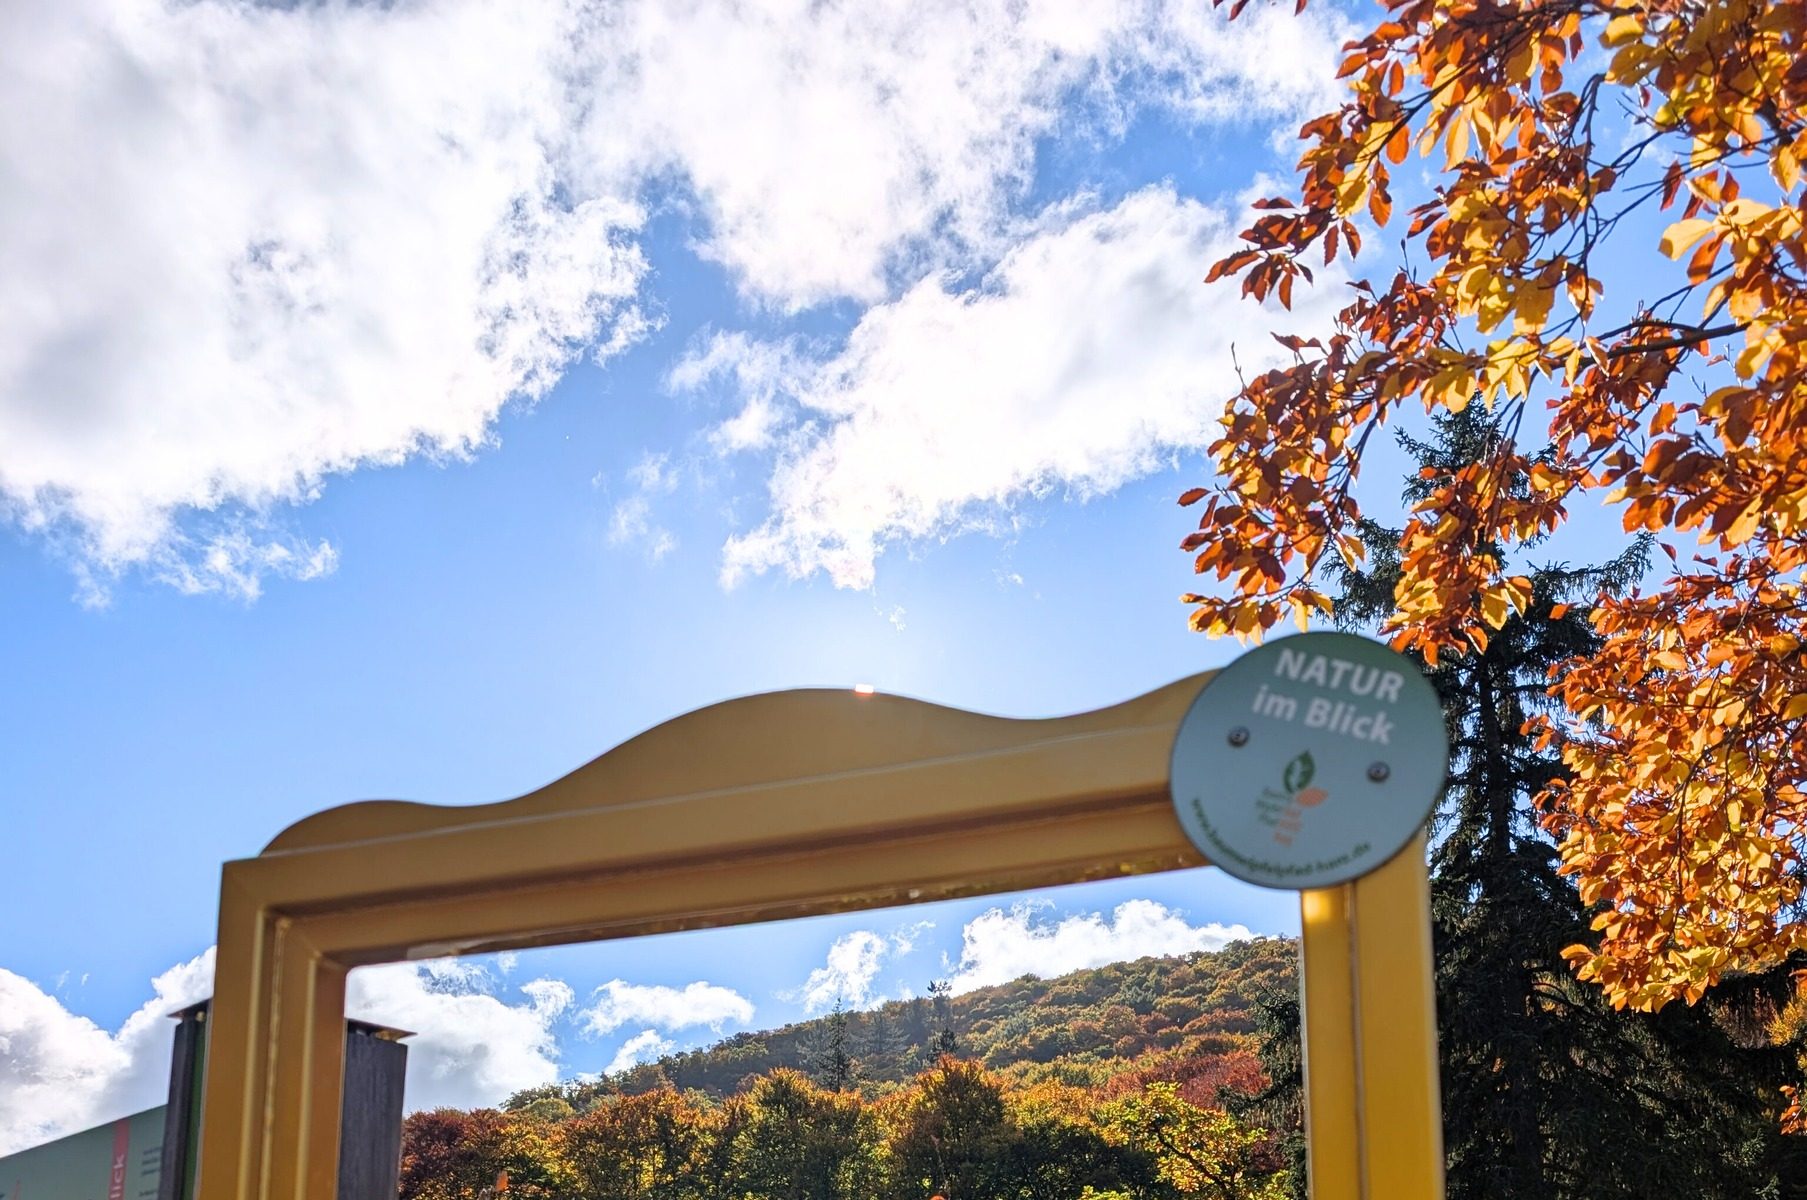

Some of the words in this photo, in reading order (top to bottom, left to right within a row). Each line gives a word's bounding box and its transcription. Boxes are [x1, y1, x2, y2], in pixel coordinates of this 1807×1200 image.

[1275, 648, 1404, 703] NATUR
[1252, 685, 1298, 721] im
[1304, 698, 1394, 744] Blick
